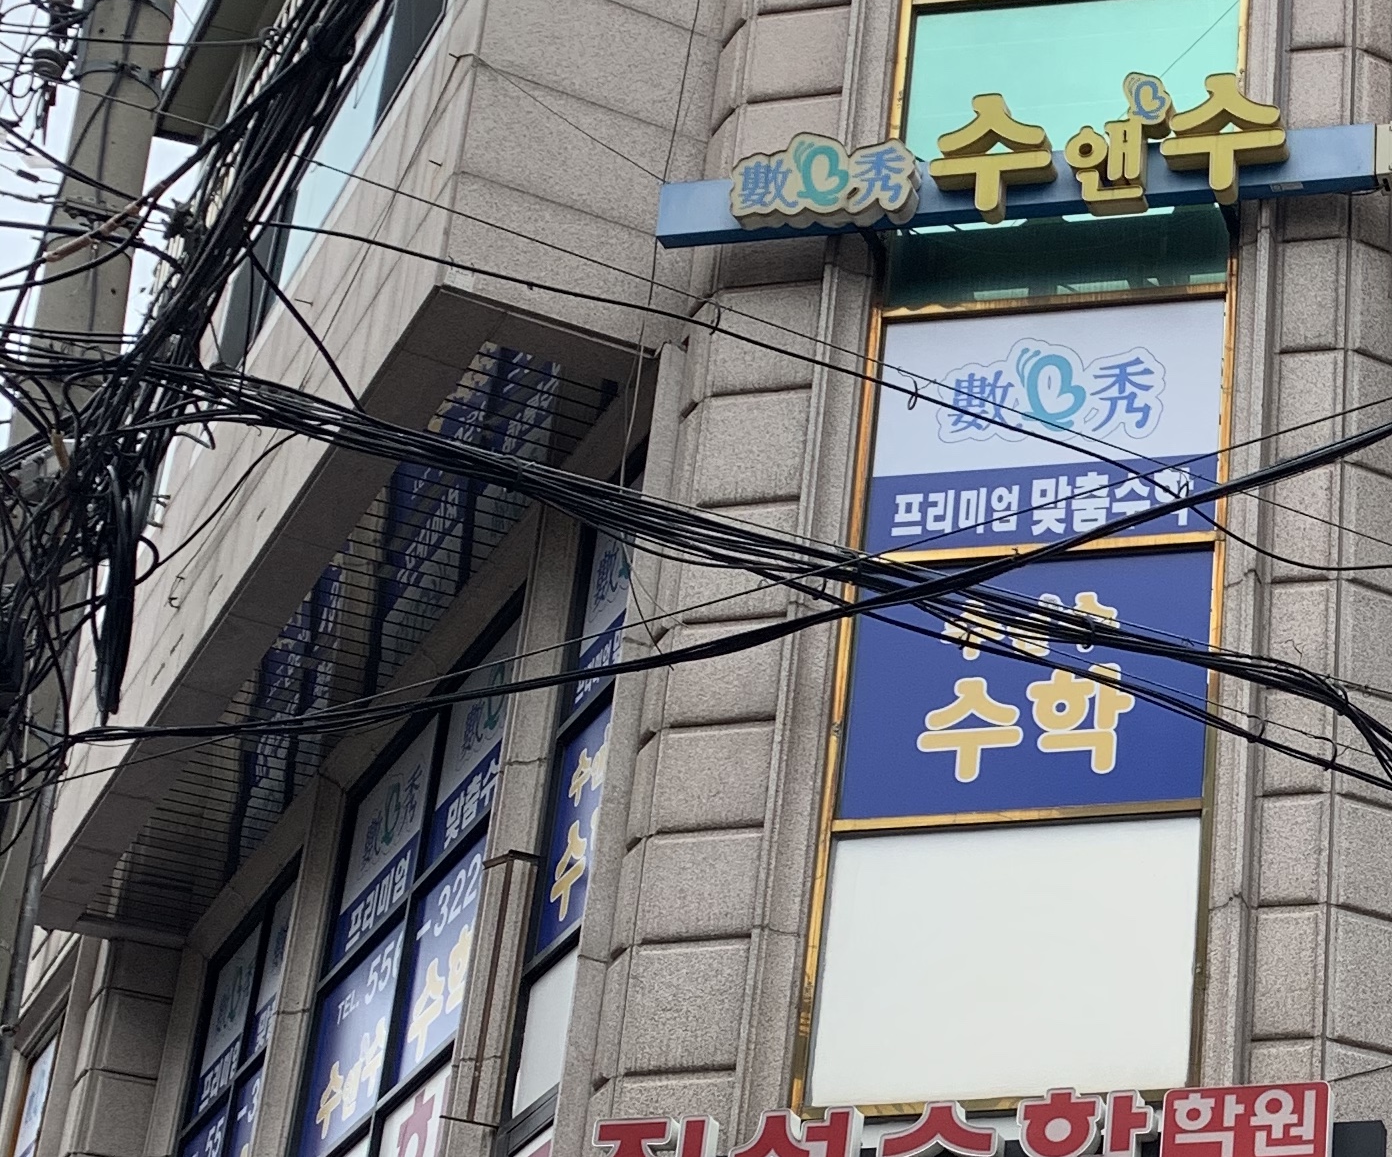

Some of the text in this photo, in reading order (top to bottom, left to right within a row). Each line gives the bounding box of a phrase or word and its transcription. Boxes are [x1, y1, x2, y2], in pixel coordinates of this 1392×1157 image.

[929, 72, 1290, 224] 수앤수
[890, 484, 1021, 537] 프리미엄
[916, 663, 1136, 783] 수학
[345, 849, 412, 952] 프리미엄
[337, 989, 360, 1025] TEL.
[1174, 1088, 1317, 1157] 학원
